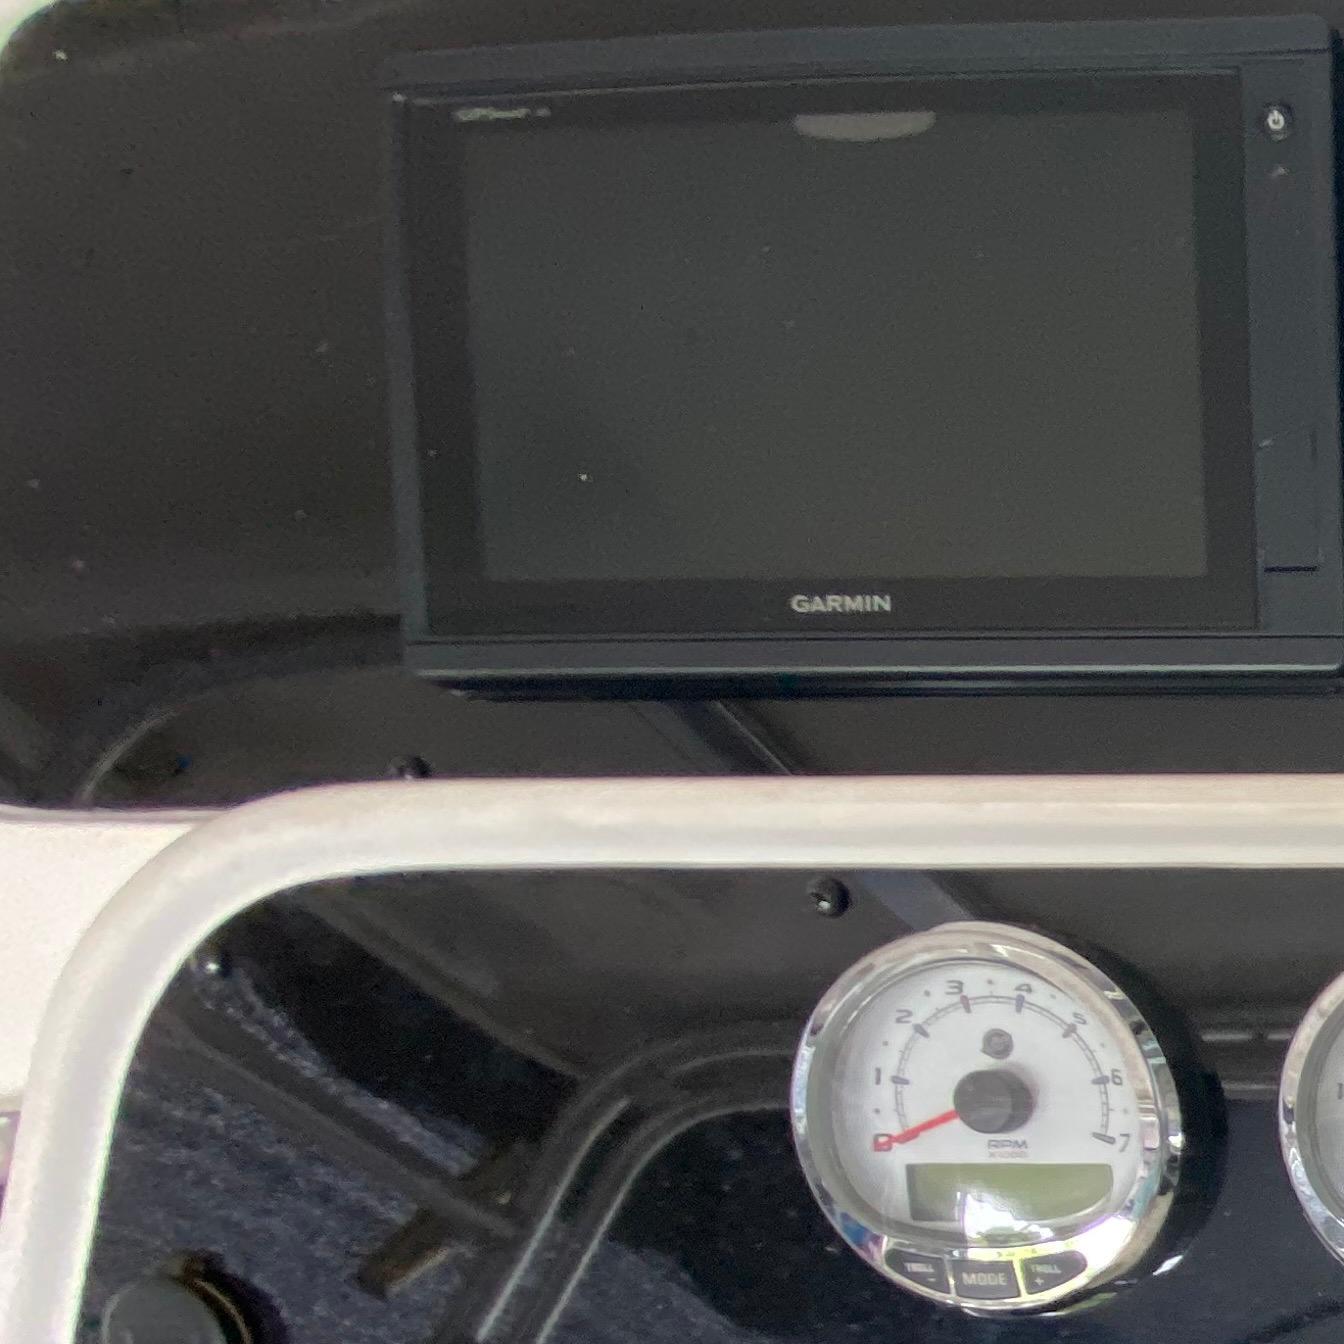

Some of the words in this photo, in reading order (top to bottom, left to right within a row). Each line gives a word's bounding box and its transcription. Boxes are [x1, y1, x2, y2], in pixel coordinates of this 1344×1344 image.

[791, 594, 891, 613] GARMIN
[945, 980, 963, 995] 3
[1014, 983, 1033, 995] 4
[895, 1010, 913, 1023] 2
[1073, 1012, 1087, 1025] 5
[874, 1067, 881, 1085] 1
[1111, 1072, 1123, 1086] 6
[988, 1139, 1028, 1149] RPM
[1118, 1133, 1131, 1152] 7
[962, 1272, 1008, 1286] MODE
